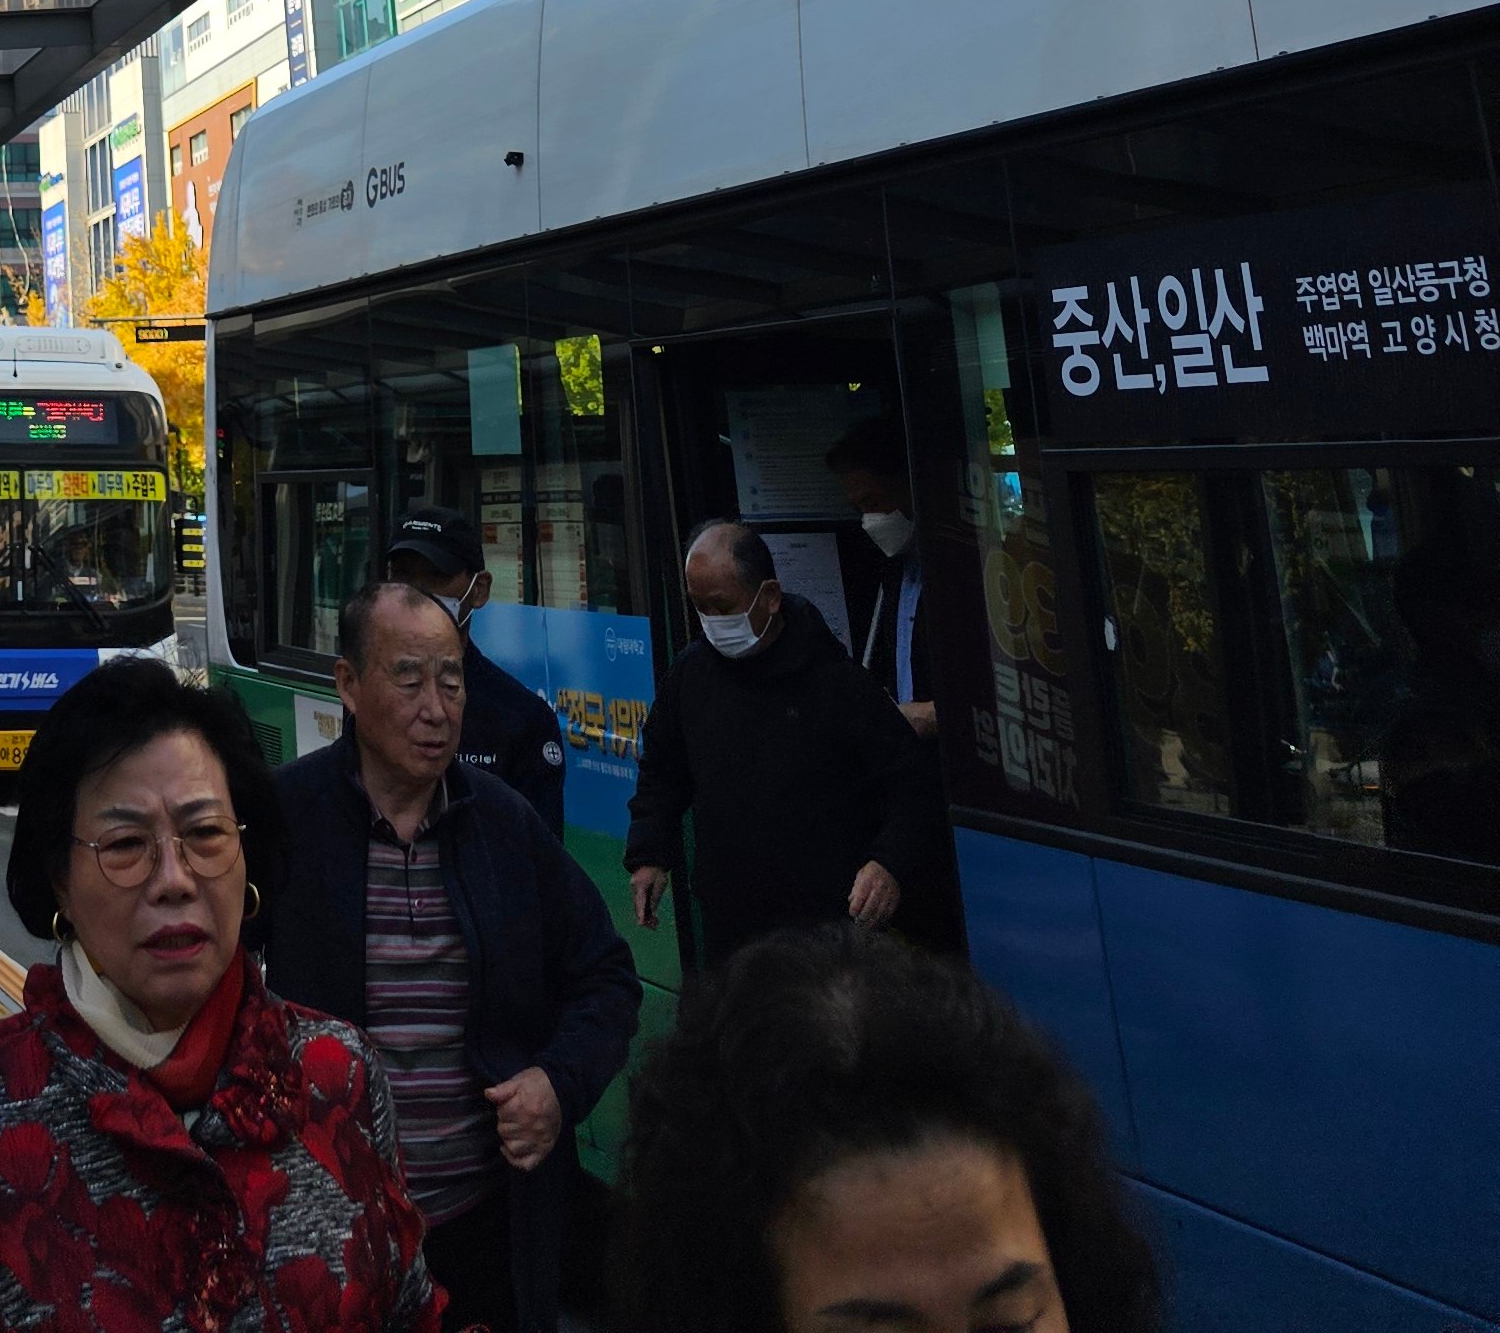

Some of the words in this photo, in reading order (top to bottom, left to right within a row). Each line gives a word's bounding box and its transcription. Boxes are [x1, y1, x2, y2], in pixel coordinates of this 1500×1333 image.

[1295, 270, 1363, 314] 주엽역
[1368, 255, 1491, 307] 일산동구청
[1051, 262, 1269, 396] 중산,일산
[1302, 319, 1372, 362] 백마역
[132, 473, 156, 497] 주엽역
